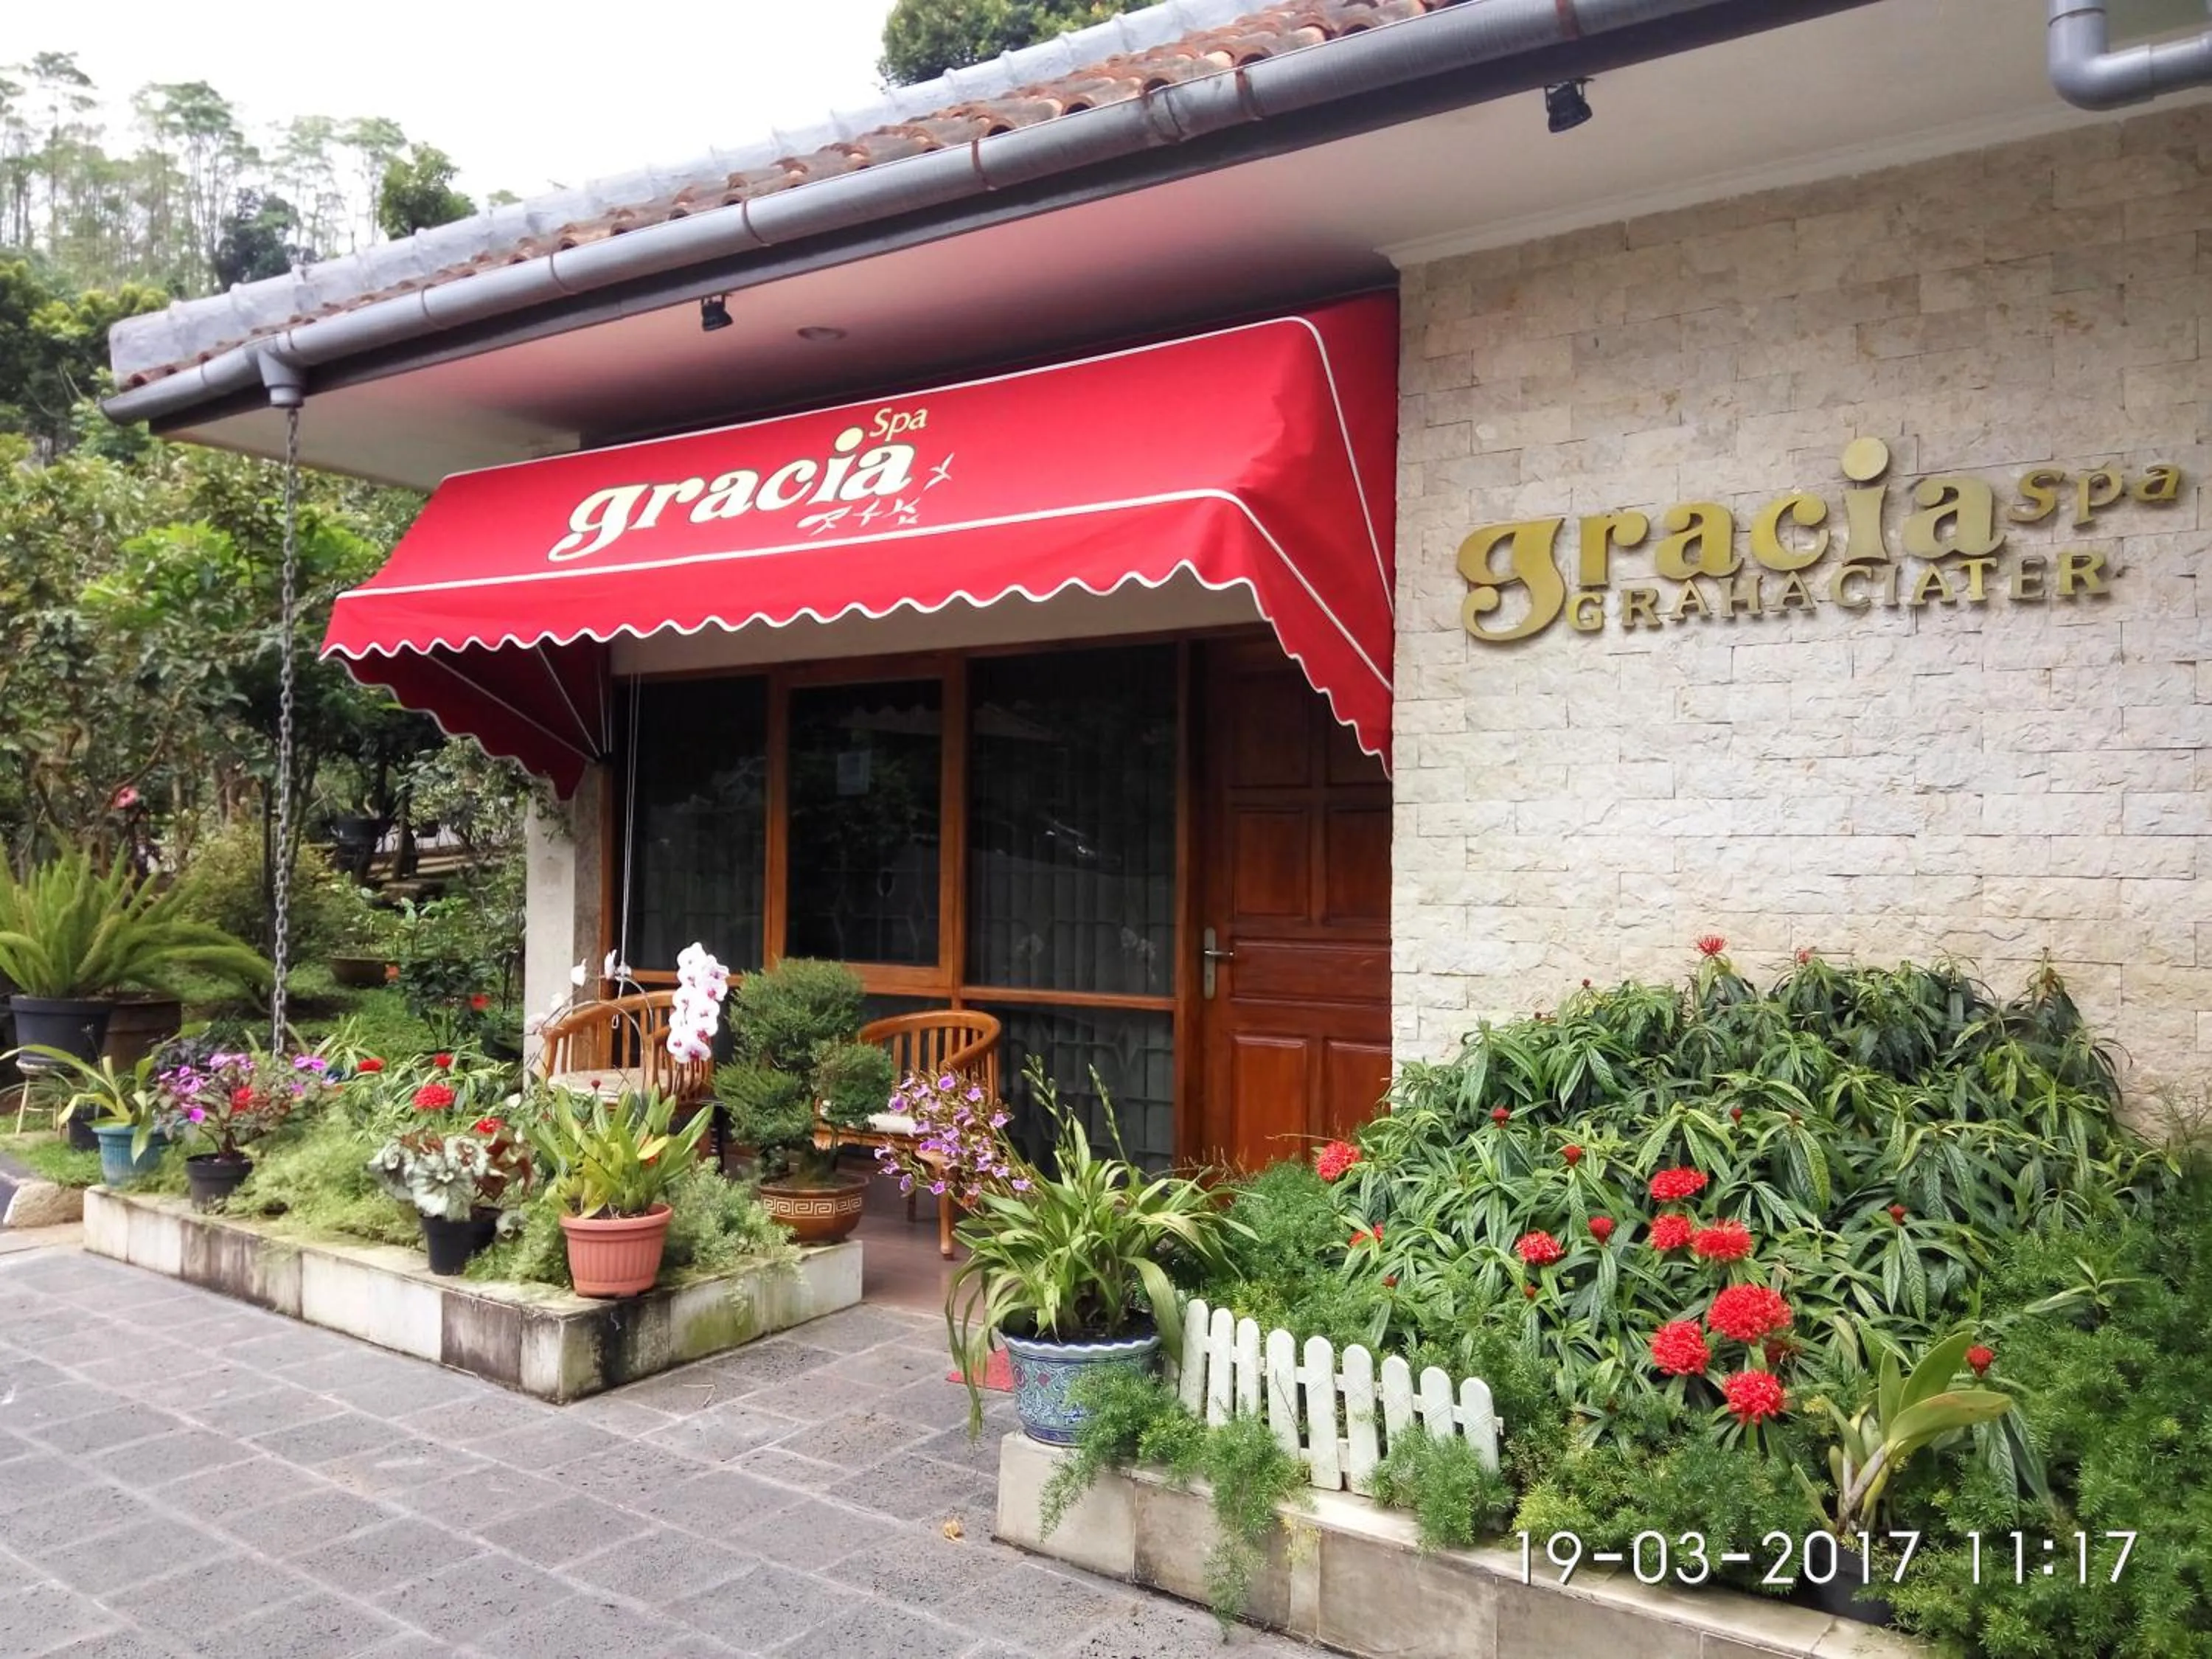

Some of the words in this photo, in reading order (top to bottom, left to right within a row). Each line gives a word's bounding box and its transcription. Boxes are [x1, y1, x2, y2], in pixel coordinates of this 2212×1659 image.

[869, 408, 929, 442] Spa
[546, 427, 916, 563] gracia
[1456, 437, 2007, 643] gracia
[2008, 462, 2181, 527] spa
